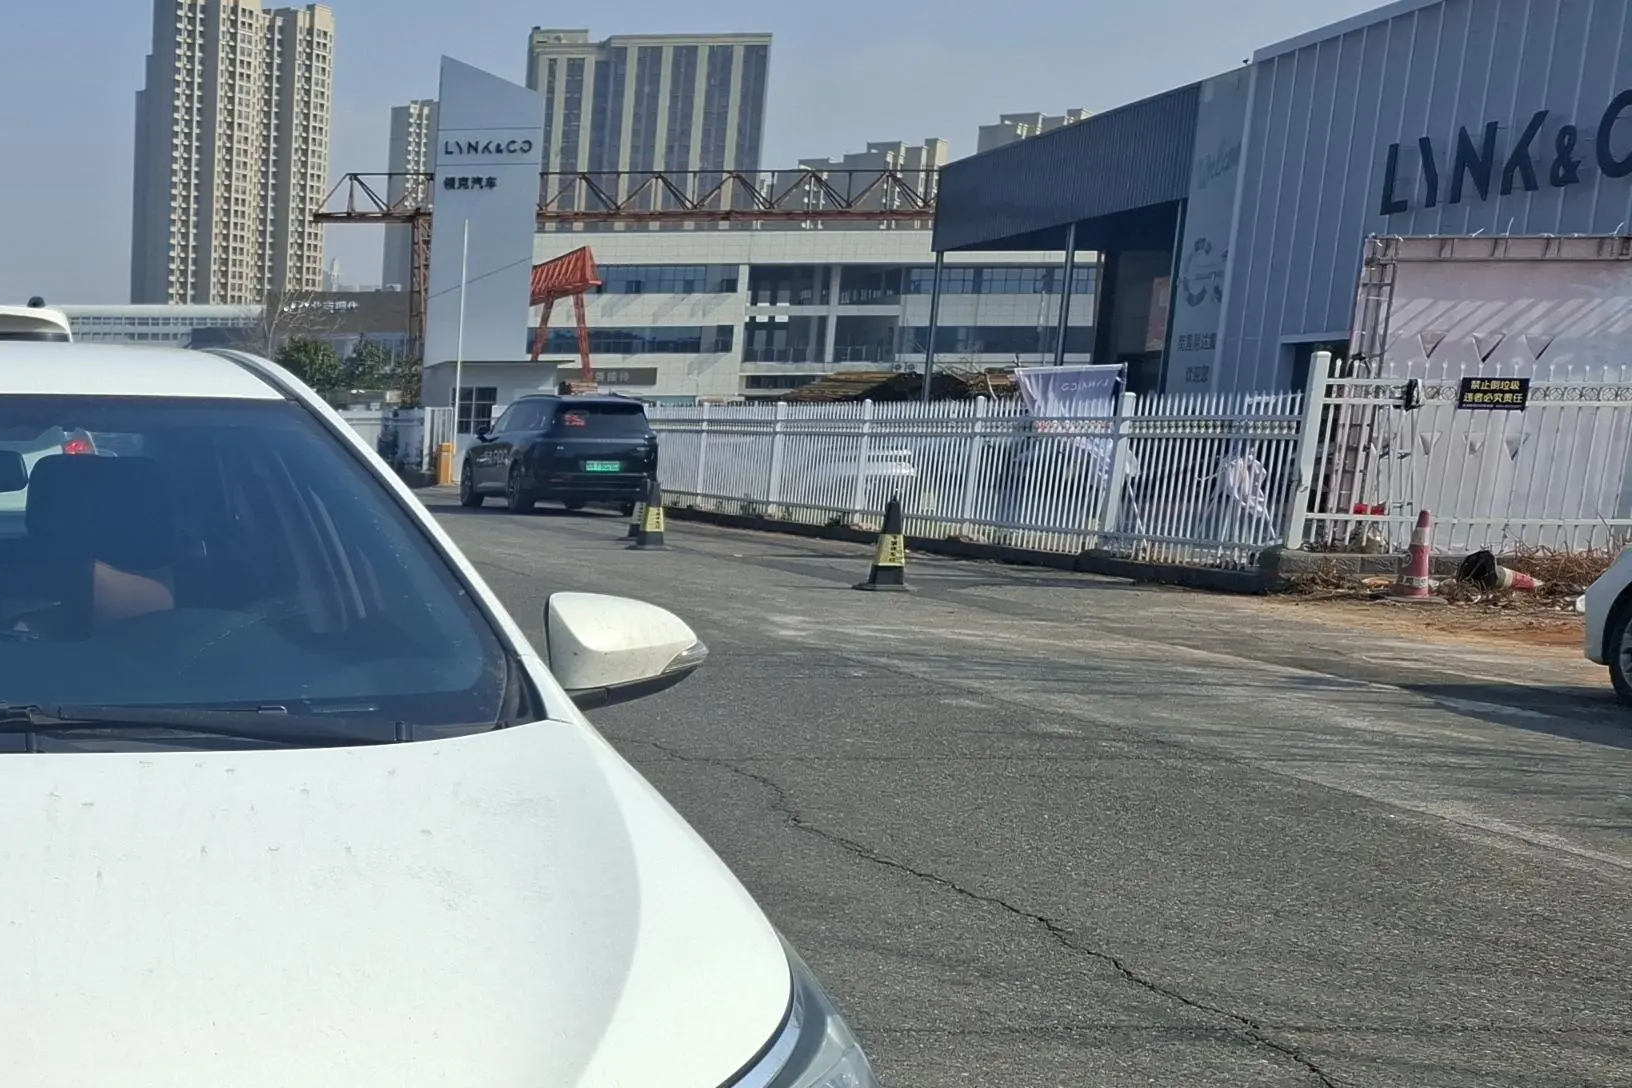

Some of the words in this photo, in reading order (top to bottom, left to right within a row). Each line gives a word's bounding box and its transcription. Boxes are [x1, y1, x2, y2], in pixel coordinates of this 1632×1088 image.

[444, 139, 533, 155] LYNK&CO
[1470, 380, 1521, 391] 禁止倒垃圾
